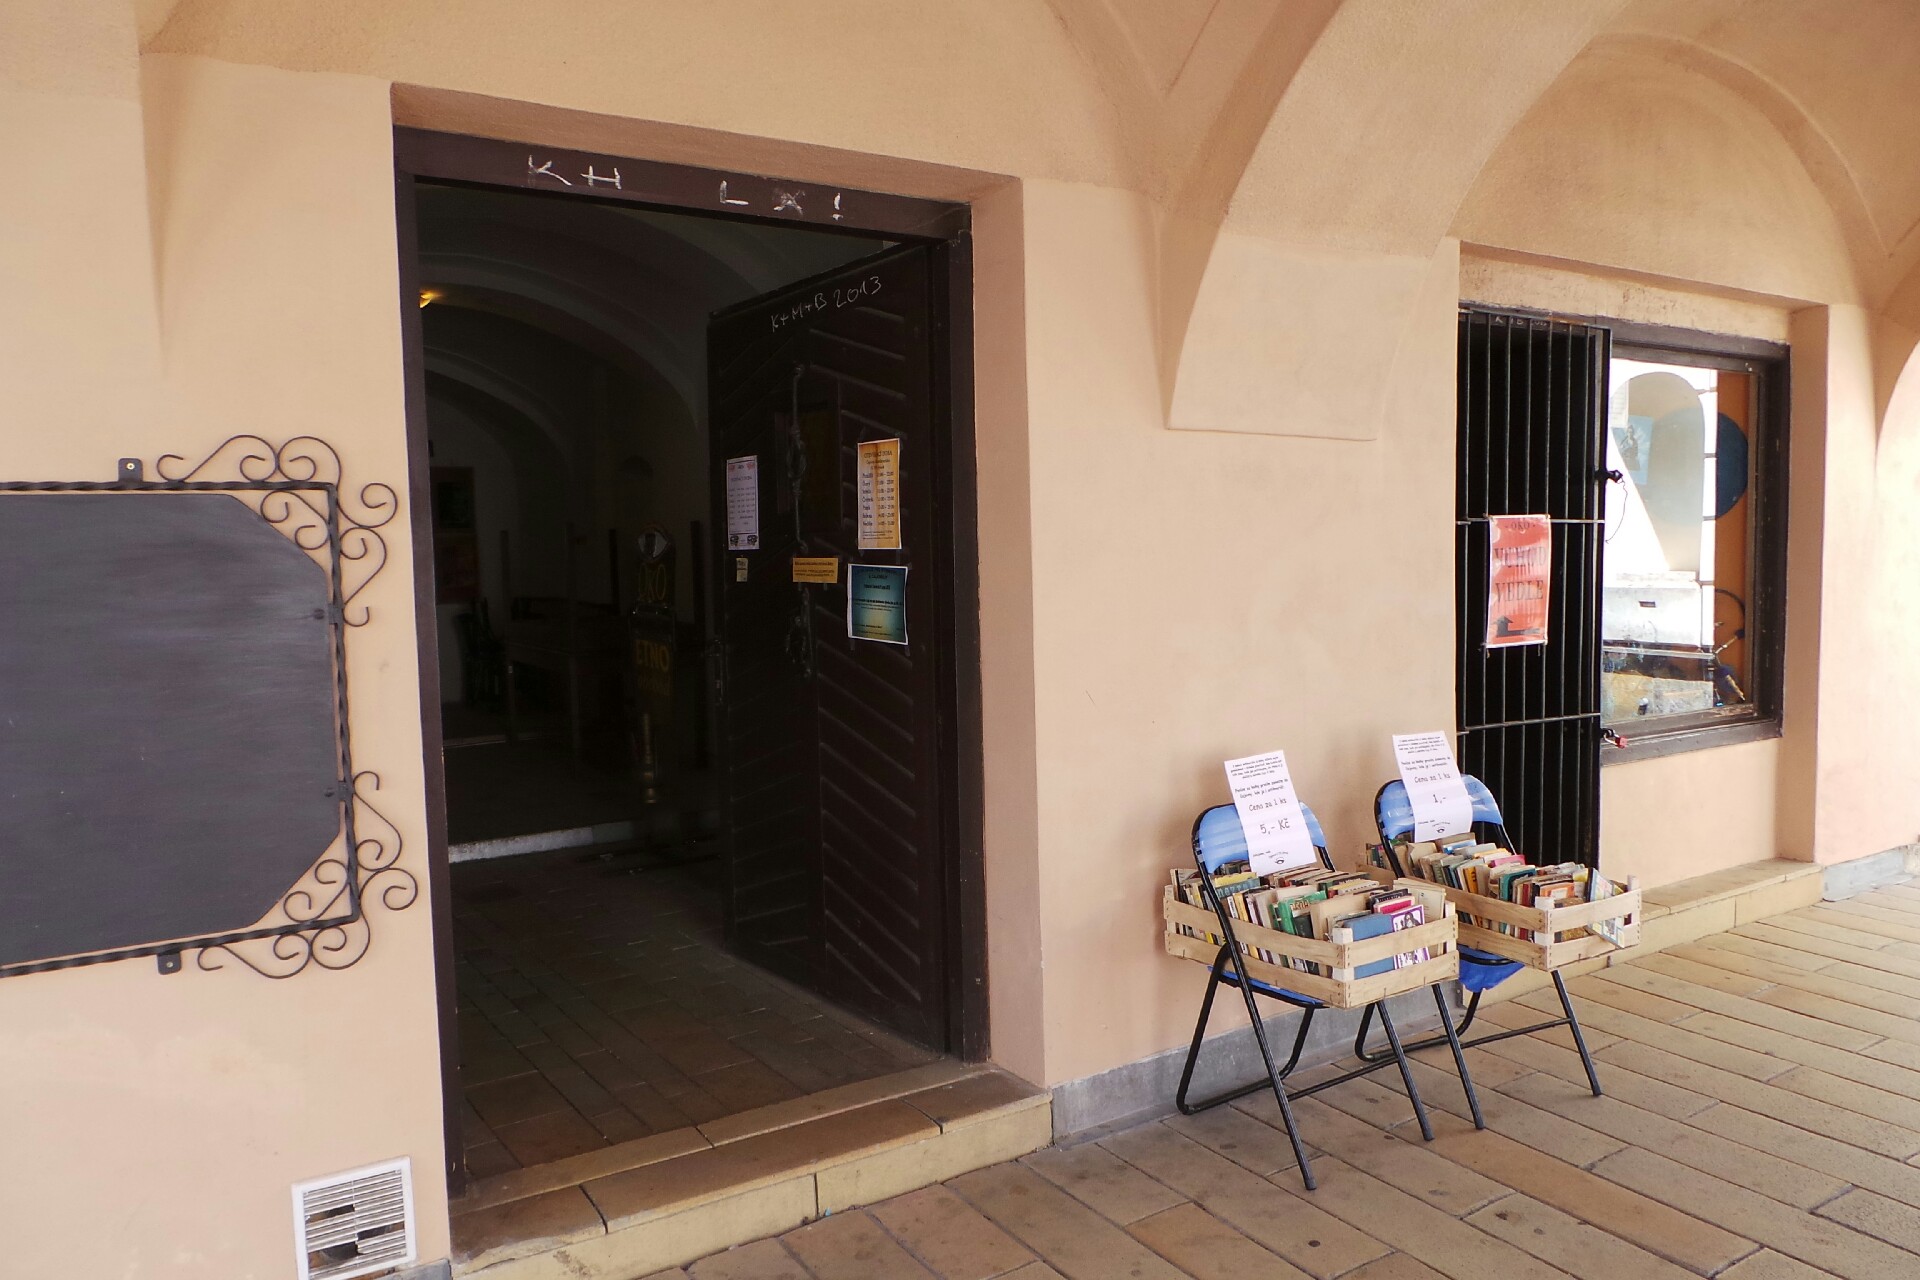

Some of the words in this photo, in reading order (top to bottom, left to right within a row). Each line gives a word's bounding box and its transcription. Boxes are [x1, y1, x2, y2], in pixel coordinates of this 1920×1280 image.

[833, 276, 882, 308] 2013
[1495, 579, 1544, 602] VEDLE
[1248, 803, 1264, 812] Cena
[1265, 801, 1273, 809] za
[1279, 797, 1288, 805] ks
[1278, 817, 1291, 831] Kč
